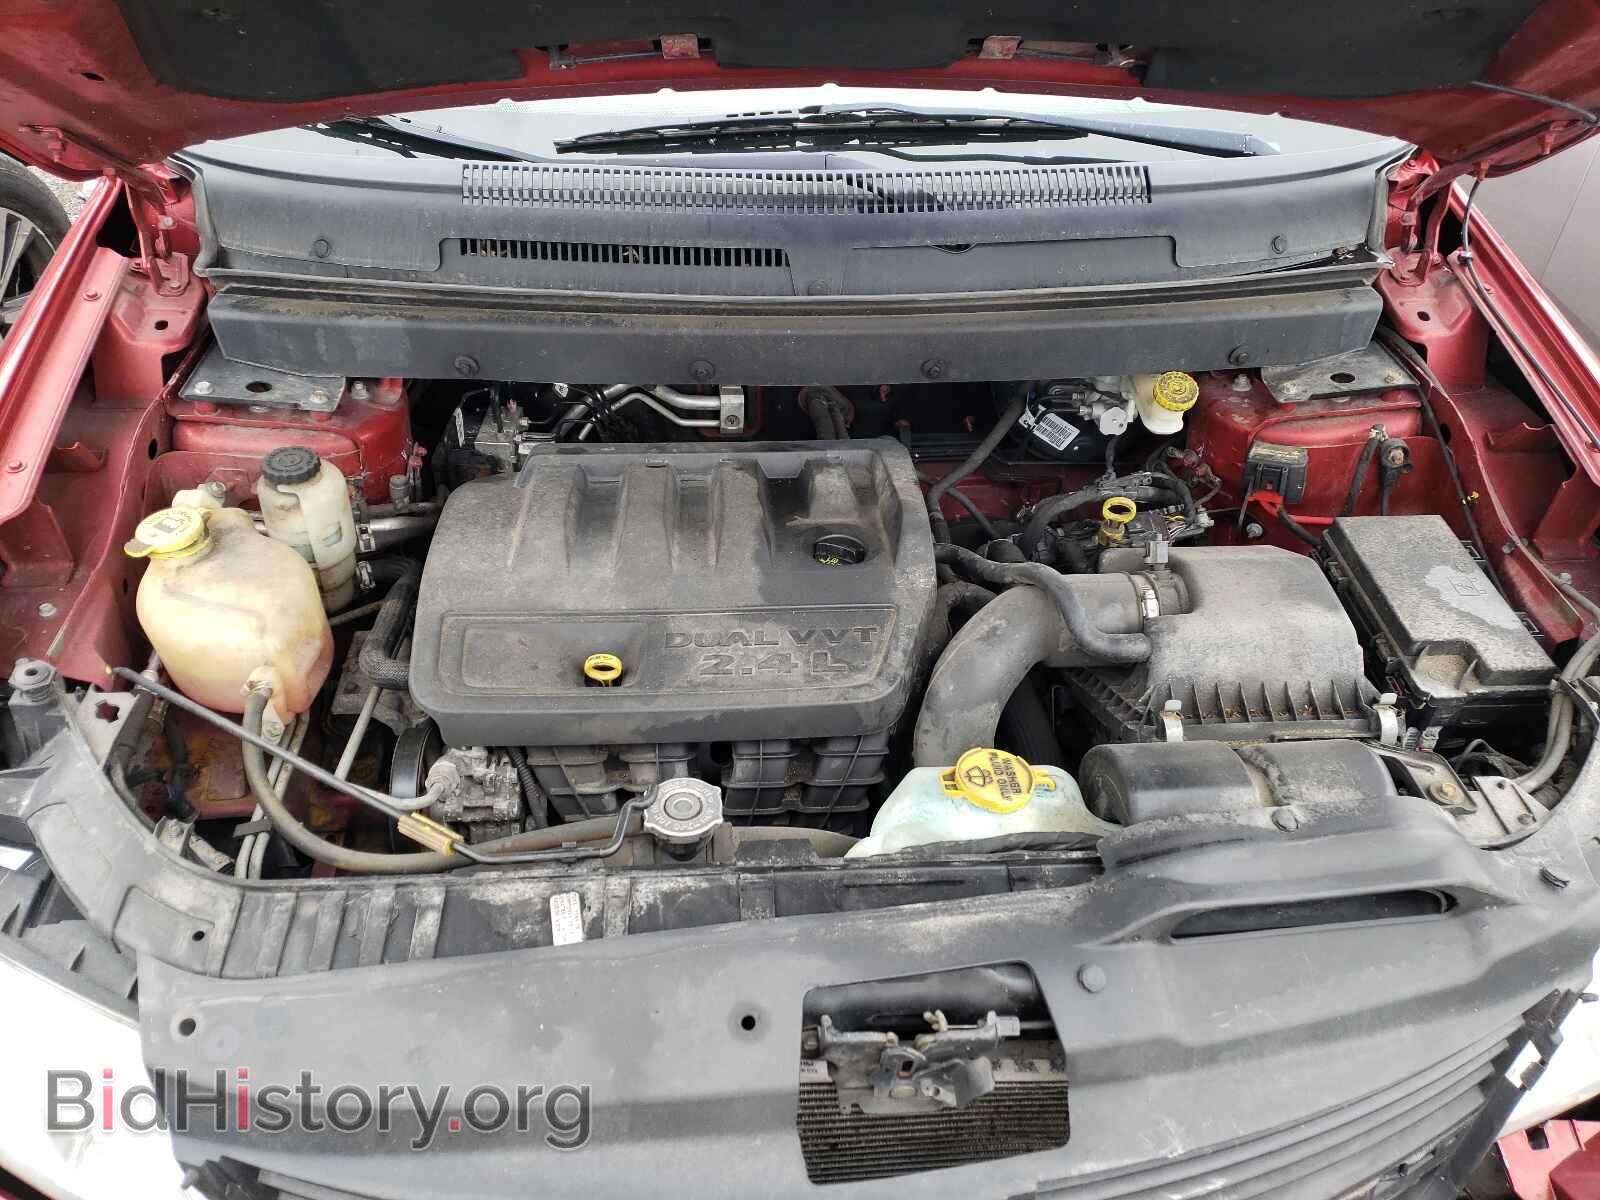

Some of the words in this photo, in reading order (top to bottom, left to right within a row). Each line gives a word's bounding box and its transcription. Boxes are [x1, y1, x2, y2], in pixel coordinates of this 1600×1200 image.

[664, 630, 781, 649] DUAL
[789, 626, 879, 646] VVT
[1002, 757, 1022, 794] WASHER
